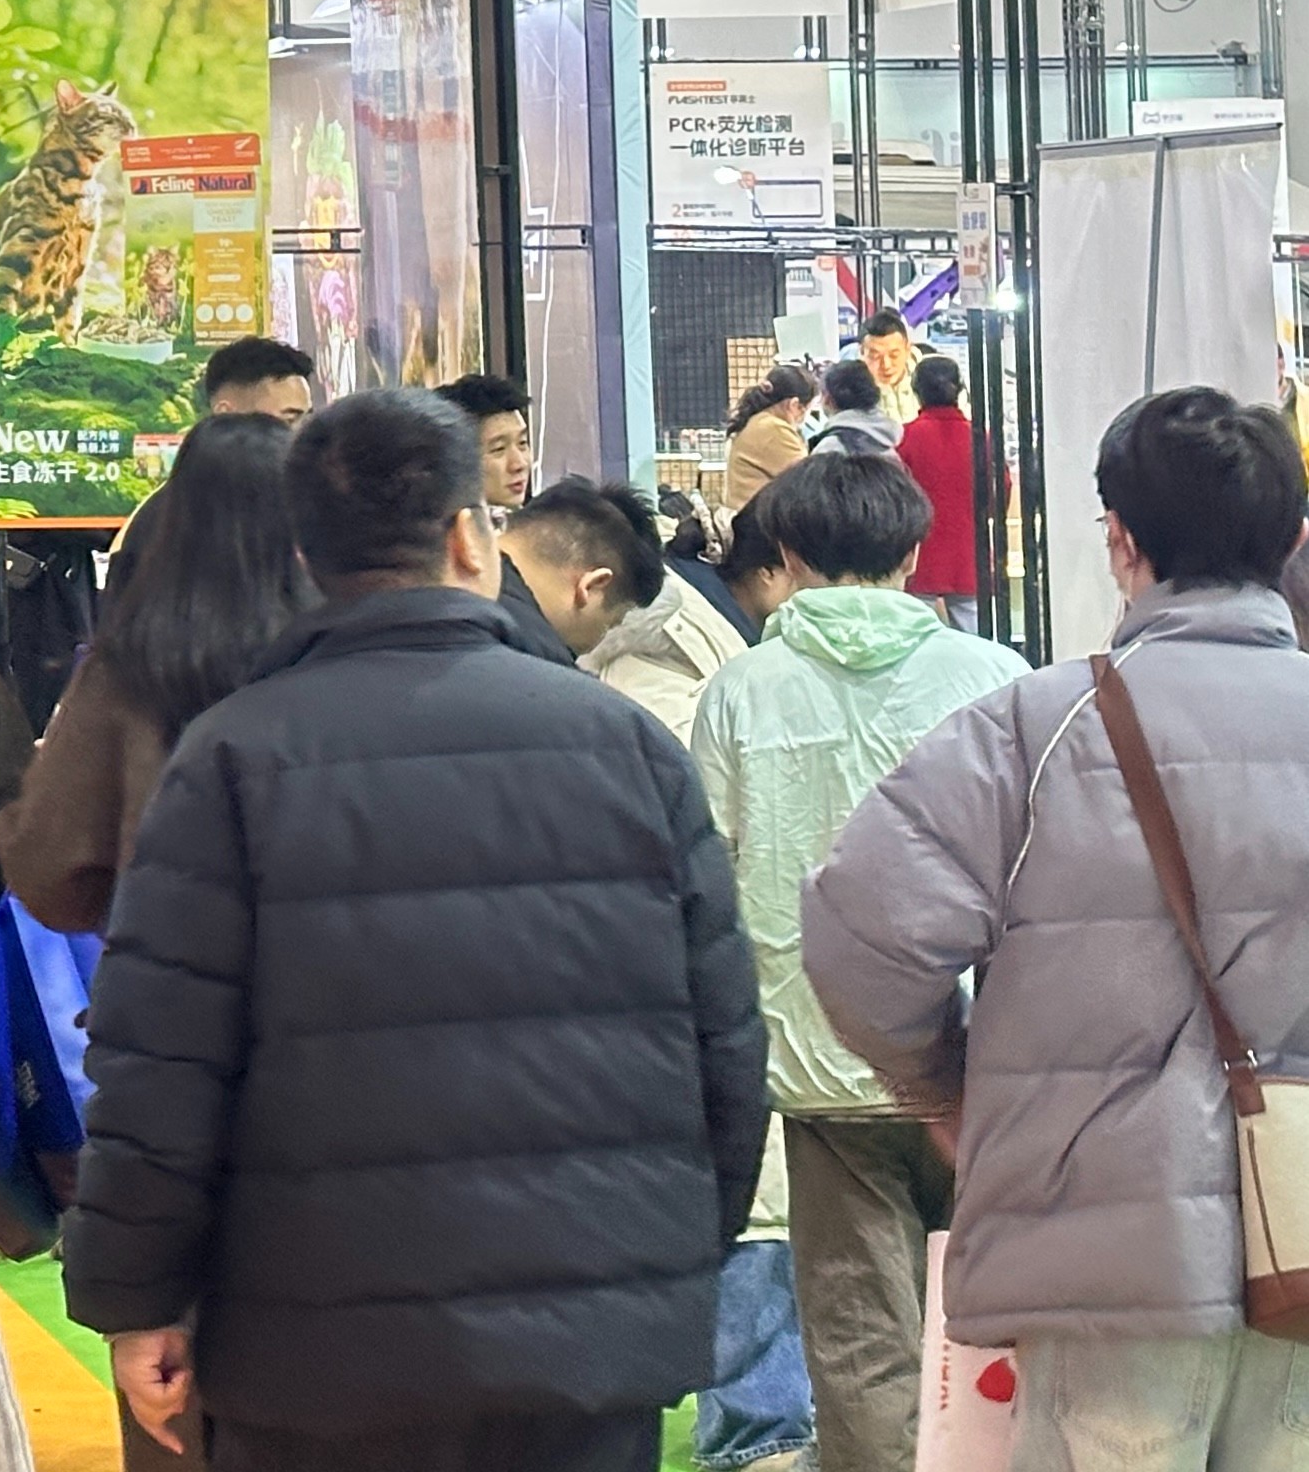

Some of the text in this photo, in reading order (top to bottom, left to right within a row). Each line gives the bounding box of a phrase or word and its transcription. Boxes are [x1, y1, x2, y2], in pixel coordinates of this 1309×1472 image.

[669, 115, 792, 134] PCR+荧光检测
[669, 137, 805, 157] 一体化诊断平台
[84, 462, 121, 482] 2.0
